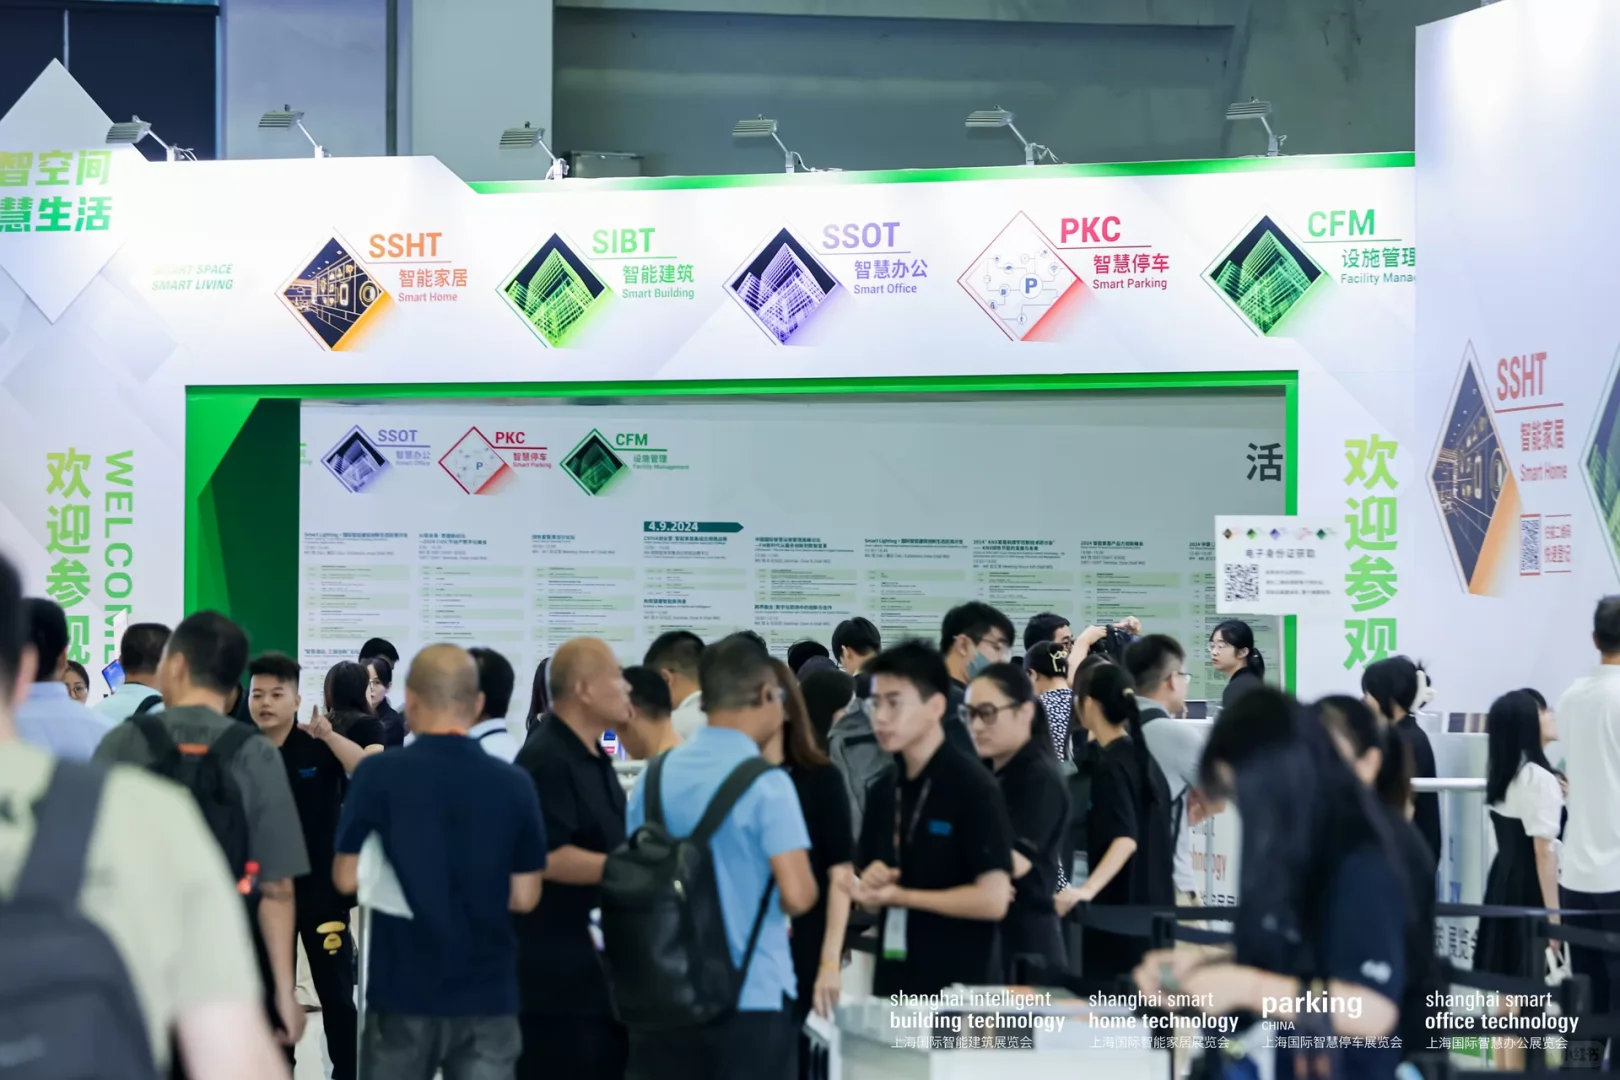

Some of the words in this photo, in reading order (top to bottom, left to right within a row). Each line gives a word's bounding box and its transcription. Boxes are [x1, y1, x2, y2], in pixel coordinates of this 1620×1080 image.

[1060, 216, 1121, 243] PKC
[1308, 209, 1375, 237] CFM
[369, 232, 443, 258] SSHT
[592, 228, 656, 254] SIBT
[822, 222, 900, 250] SSOT
[1093, 253, 1170, 274] 智慧停车
[1341, 247, 1416, 268] 设施管理
[196, 263, 234, 275] SPACE
[398, 268, 468, 288] 智能家居
[622, 264, 695, 284] 智能建筑
[854, 258, 928, 280] 智慧办公
[1340, 272, 1380, 285] Facility
[151, 279, 193, 290] SMART
[195, 279, 234, 290] LIVING
[621, 288, 652, 299] Smart
[654, 287, 695, 300] Building
[853, 284, 884, 294] Smart
[887, 283, 918, 294] Office
[1092, 279, 1124, 290] Smart
[1127, 277, 1168, 291] Parking
[398, 292, 427, 302] Smart
[430, 291, 458, 302] Home
[1497, 352, 1547, 401] SSHT
[377, 429, 418, 442] SSOT
[495, 431, 526, 444] PKC
[615, 433, 648, 446] CFM
[1246, 442, 1283, 481] 活
[648, 521, 699, 532] 4.9.2024
[1343, 434, 1399, 670] 欢迎参观
